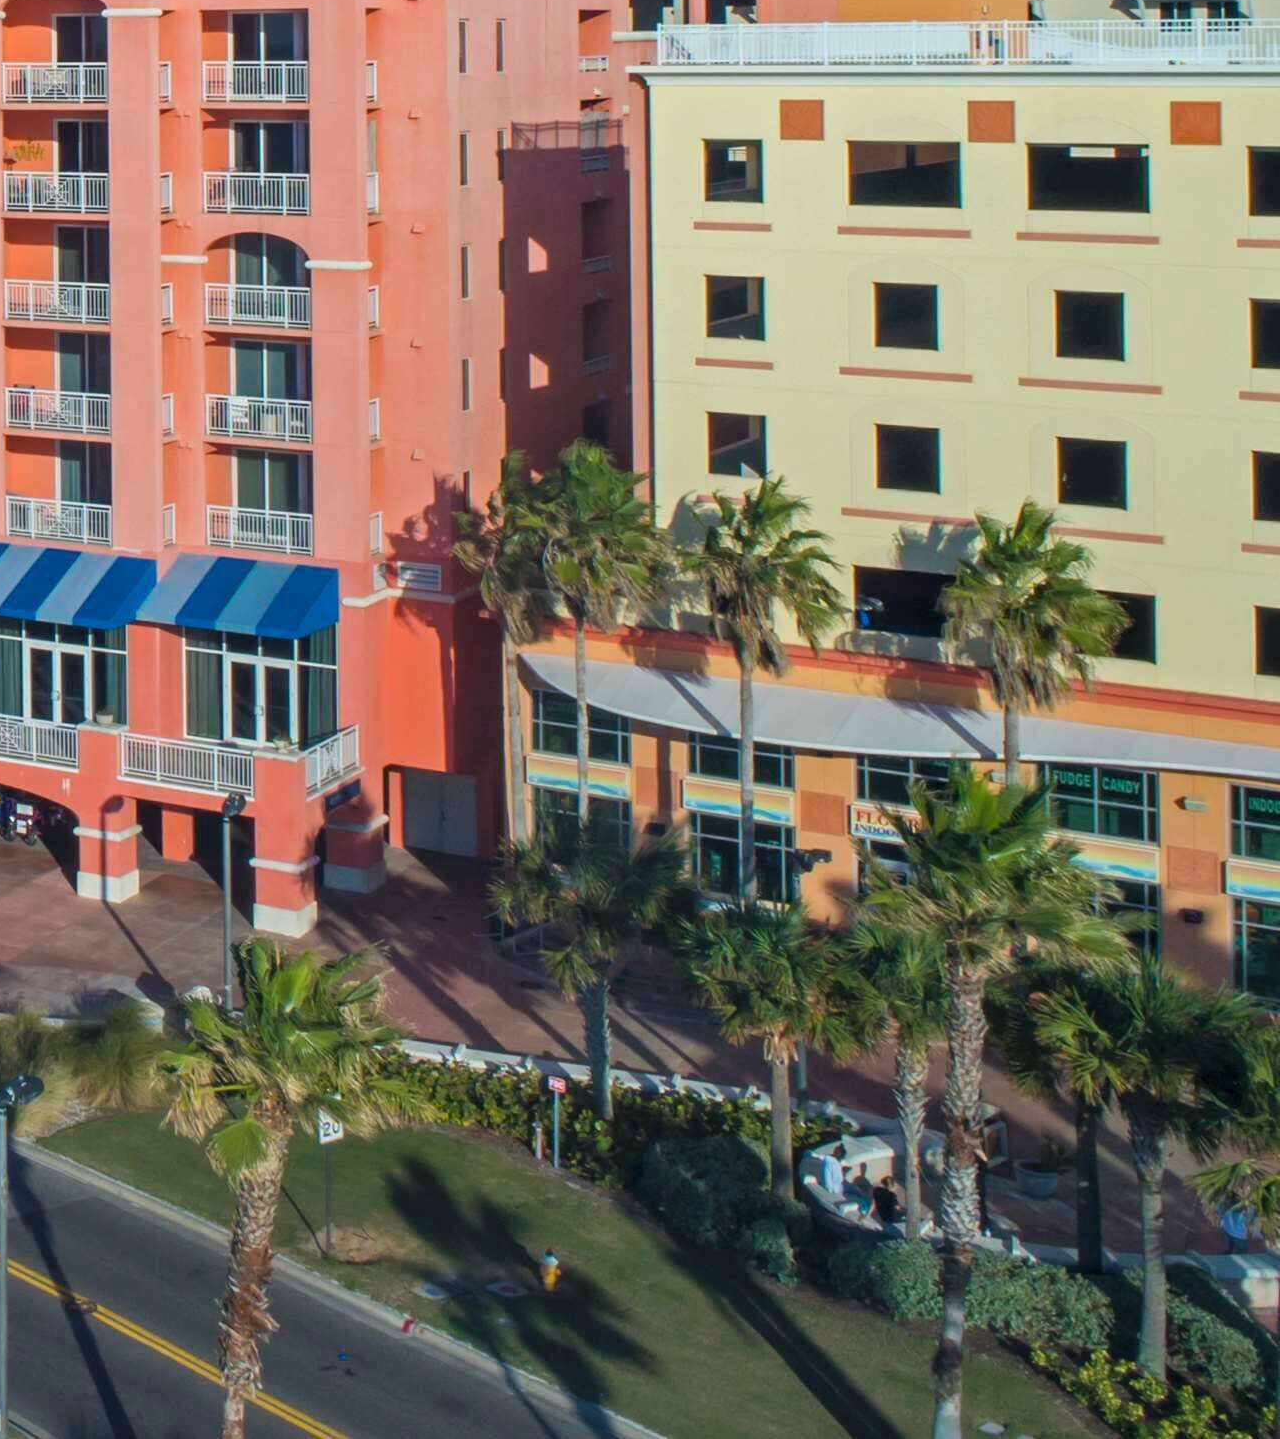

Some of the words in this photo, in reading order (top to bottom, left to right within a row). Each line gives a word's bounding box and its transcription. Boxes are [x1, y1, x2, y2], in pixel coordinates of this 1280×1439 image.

[1052, 769, 1092, 787] FUDGE
[1102, 776, 1140, 794] CANDY
[322, 1121, 340, 1138] 20
